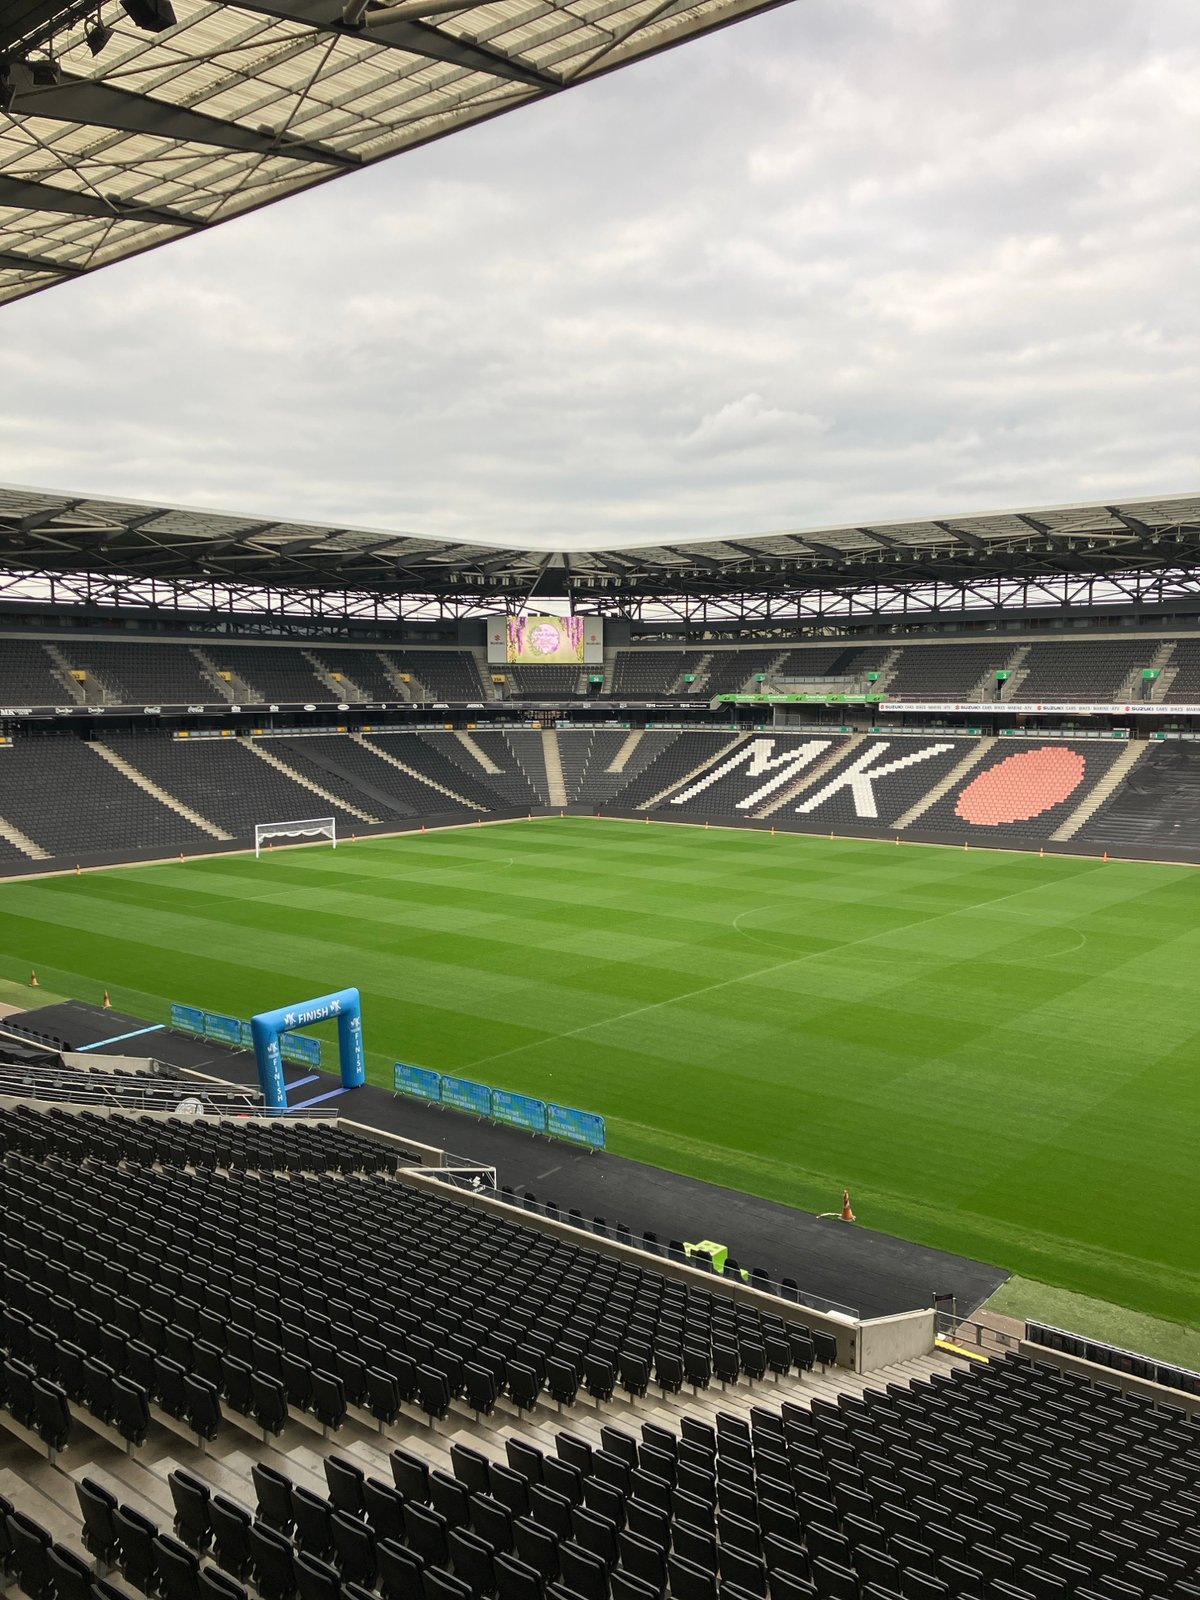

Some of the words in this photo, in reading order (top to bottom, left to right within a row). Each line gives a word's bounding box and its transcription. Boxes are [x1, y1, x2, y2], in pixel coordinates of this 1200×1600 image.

[298, 1007, 329, 1024] FINISH
[354, 1032, 362, 1074] FINISH
[272, 1058, 283, 1102] FINISH
